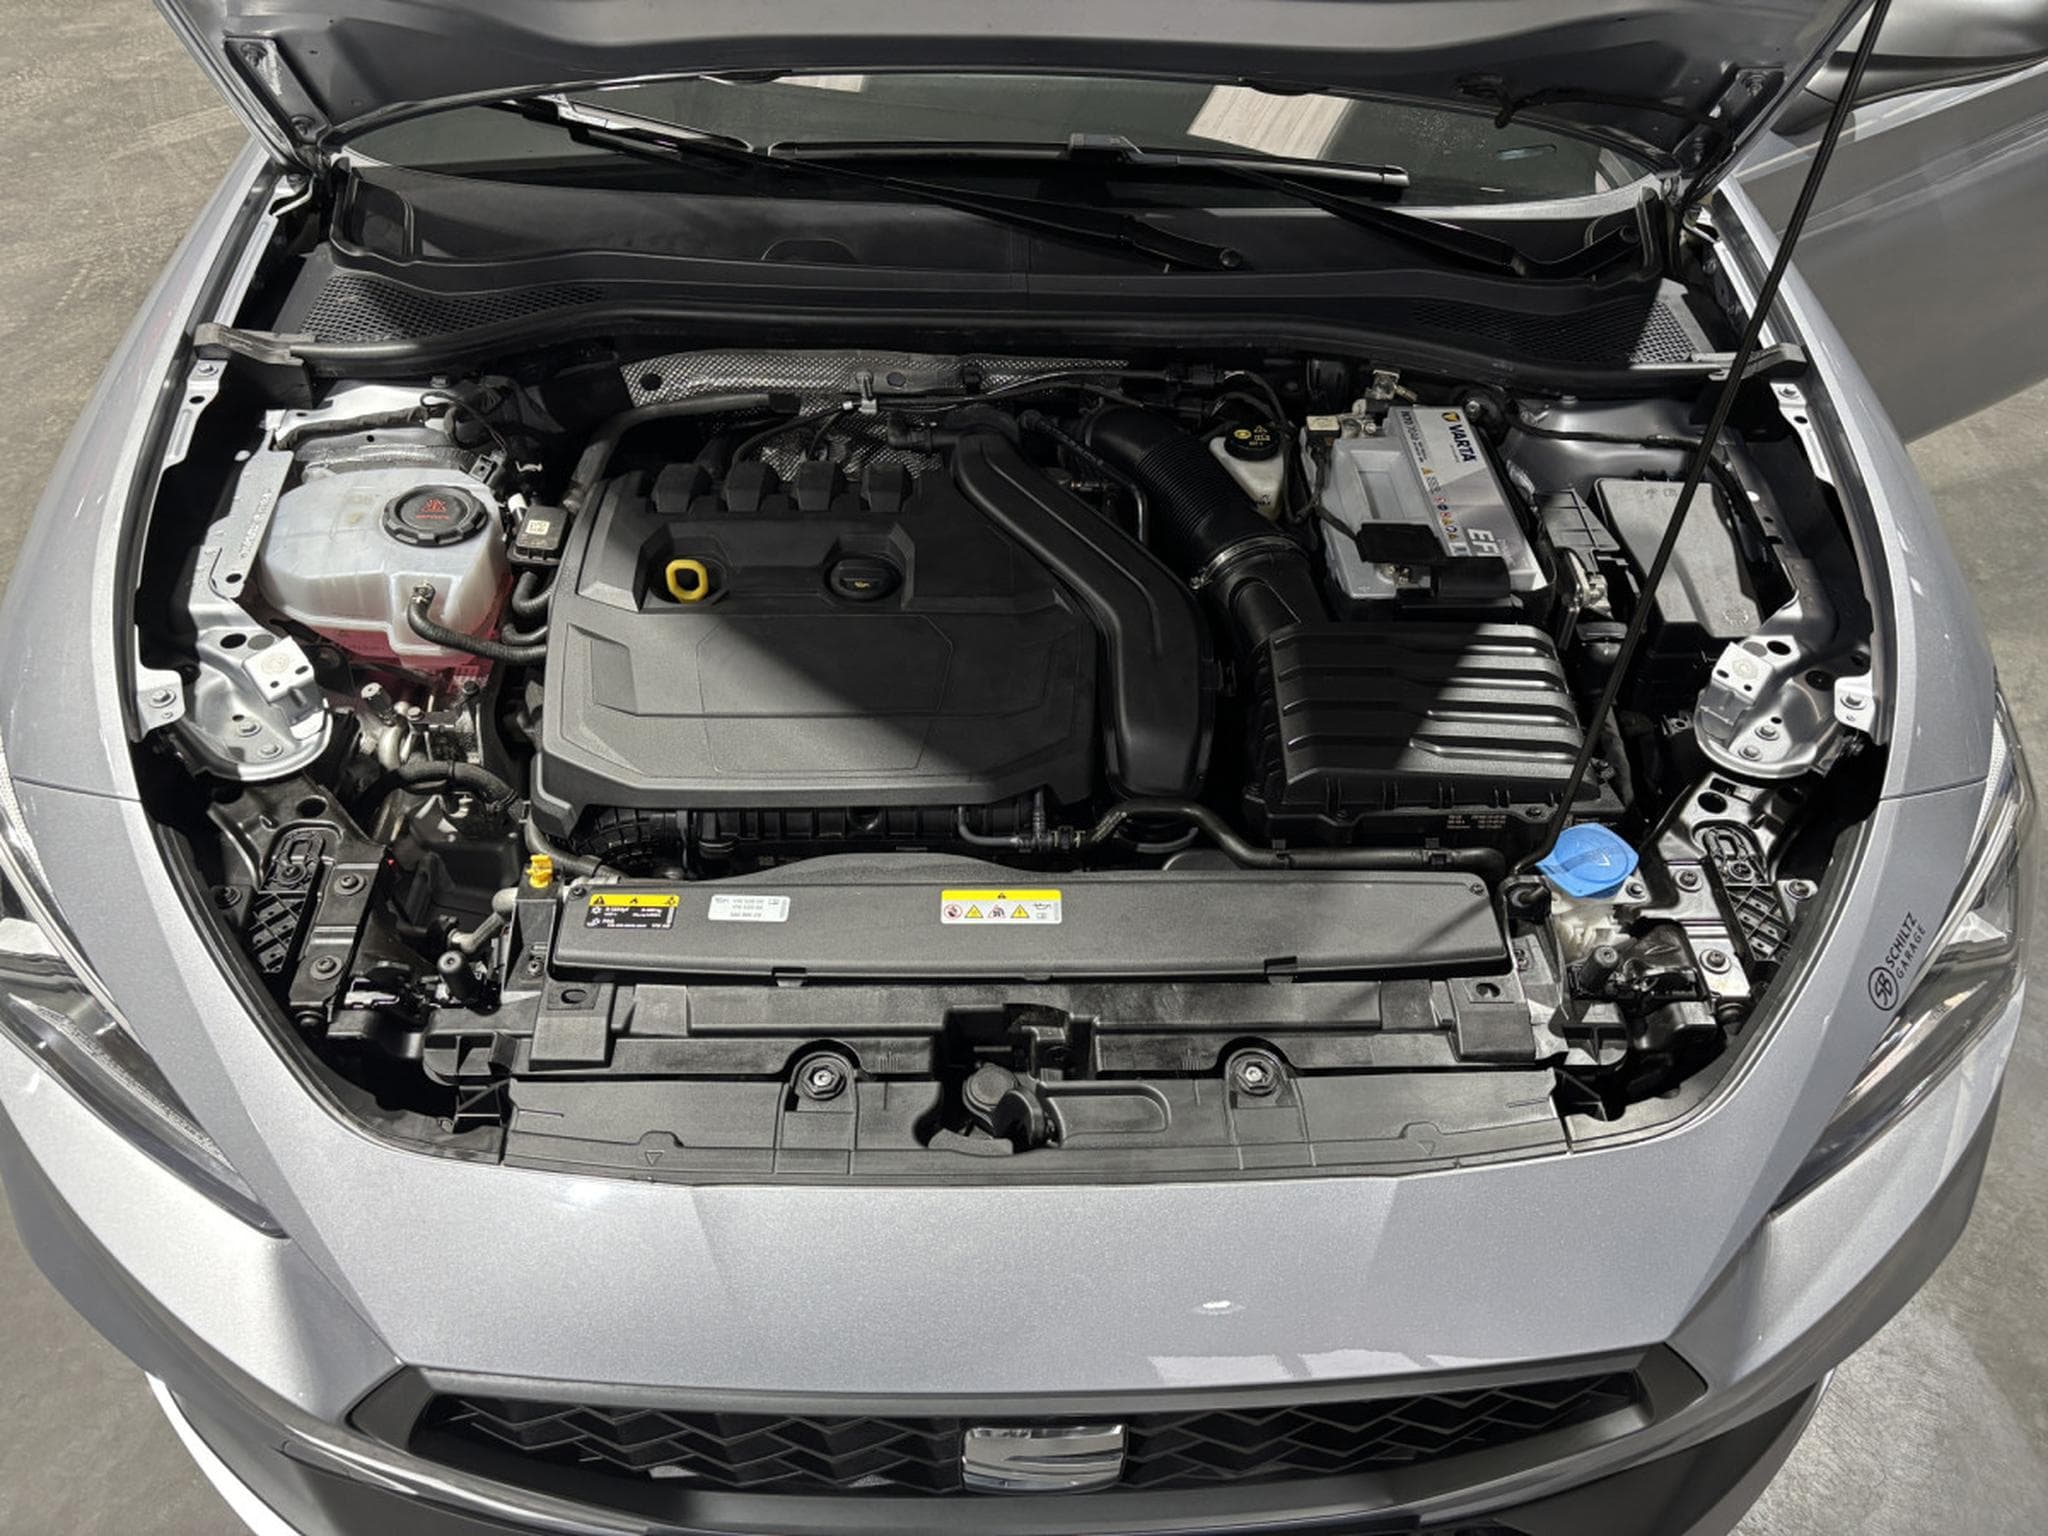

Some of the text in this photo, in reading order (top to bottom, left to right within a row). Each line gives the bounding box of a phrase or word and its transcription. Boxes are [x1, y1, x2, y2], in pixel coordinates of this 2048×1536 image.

[1449, 424, 1477, 462] VARTA
[1468, 528, 1502, 556] EF
[1886, 912, 1917, 968] SCHILTZ
[1896, 926, 1926, 979] GARAGE
